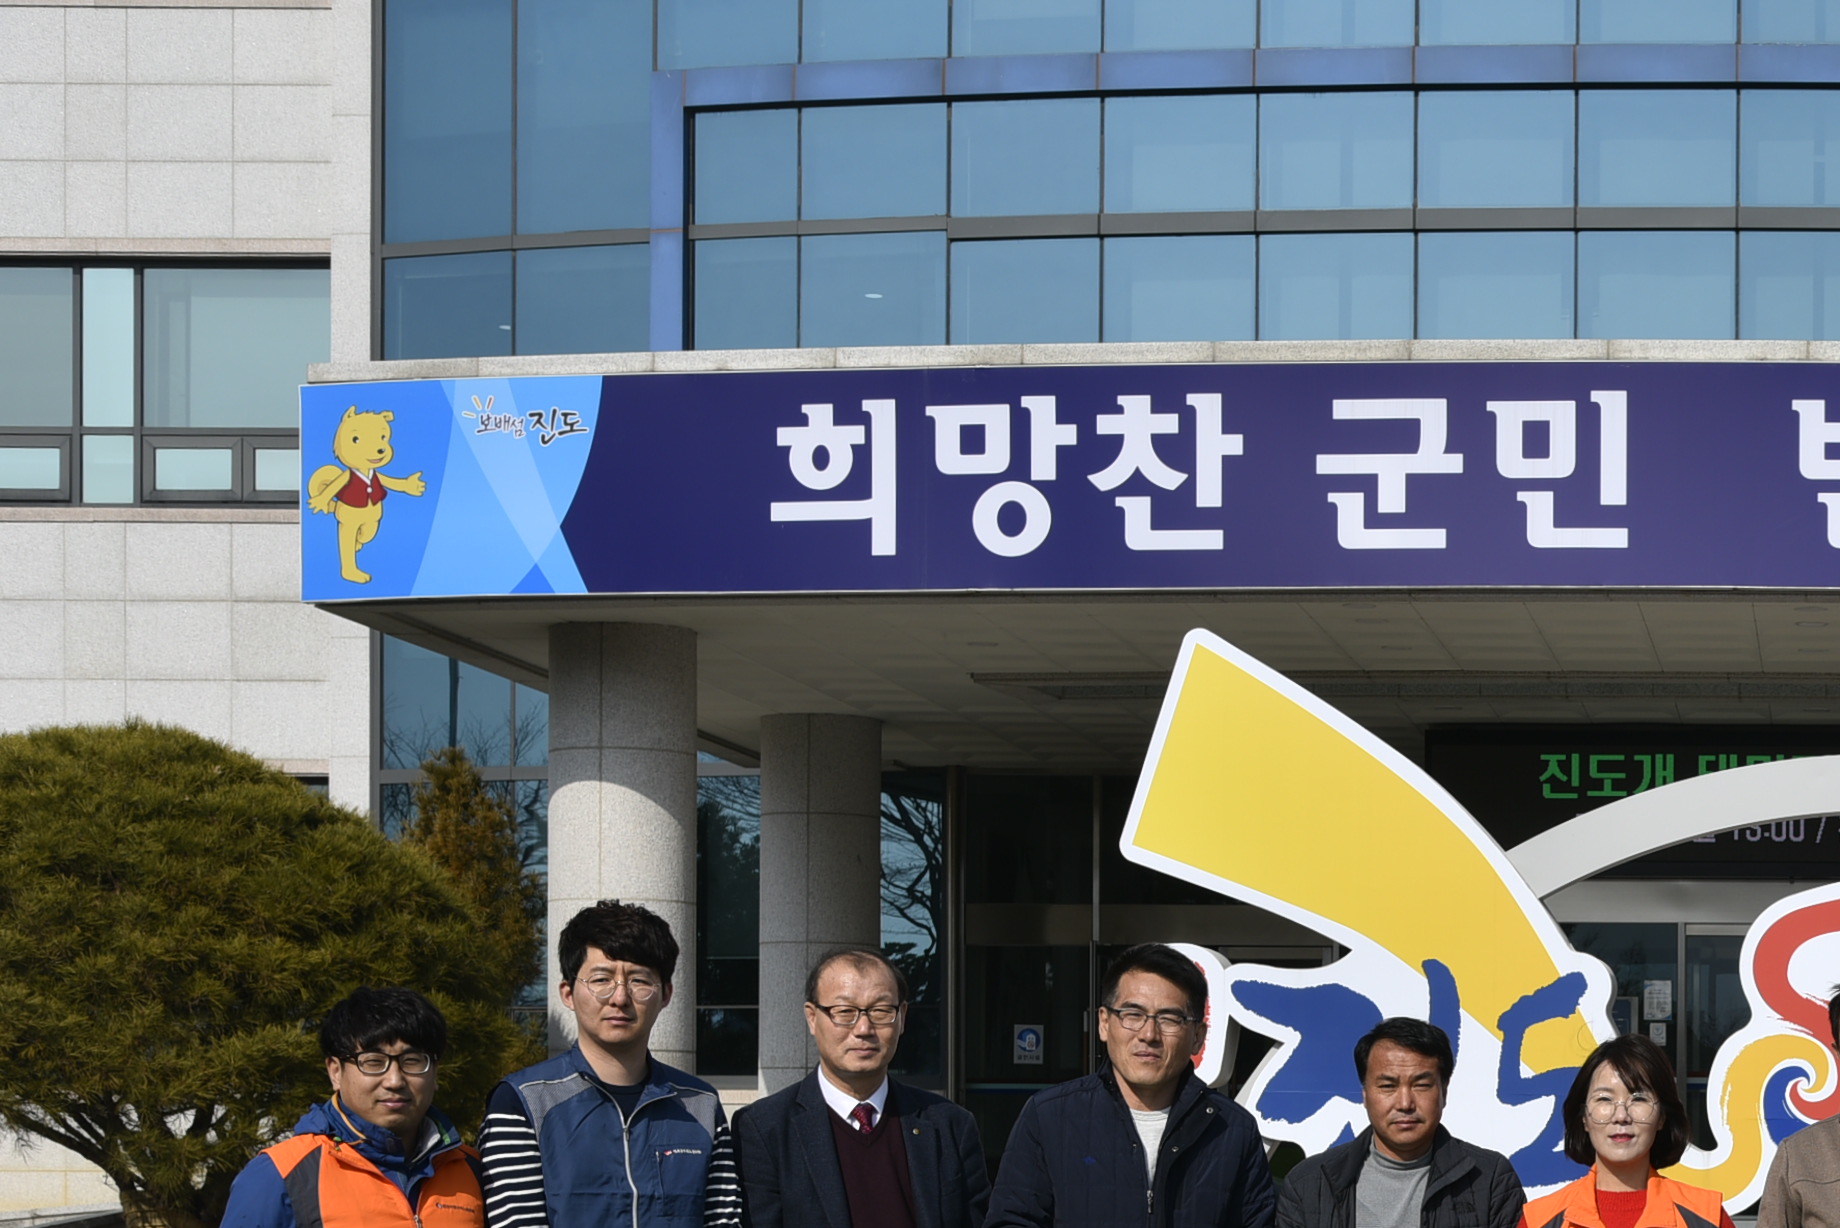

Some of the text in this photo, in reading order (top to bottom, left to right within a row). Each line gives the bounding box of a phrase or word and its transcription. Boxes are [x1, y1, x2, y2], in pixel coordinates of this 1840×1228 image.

[476, 408, 588, 446] 보배섬 진도
[771, 393, 1243, 556] 희망찬
[1316, 391, 1628, 549] 군민
[1539, 753, 1675, 799] 진도개
